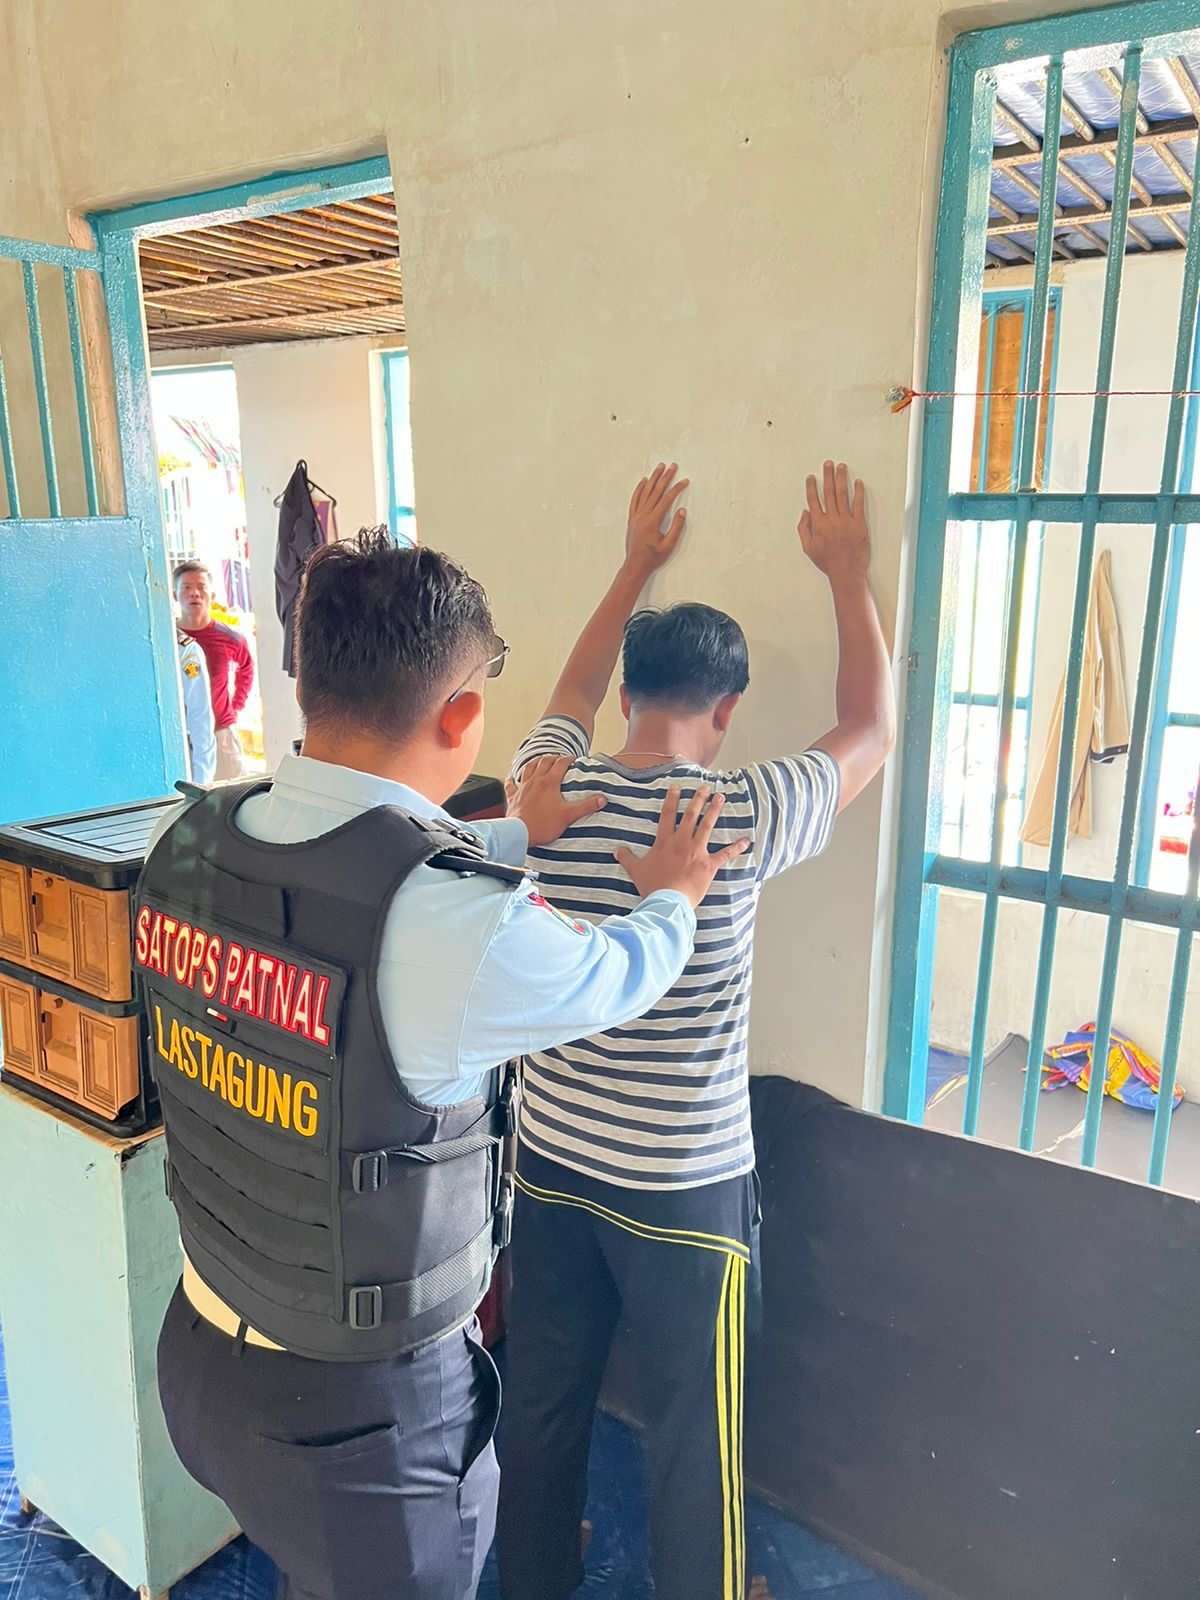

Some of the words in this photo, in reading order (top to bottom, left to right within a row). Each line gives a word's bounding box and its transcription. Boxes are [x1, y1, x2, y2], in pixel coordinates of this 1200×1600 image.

[135, 906, 222, 998] SATOPS
[220, 942, 330, 1046] PATNAL
[155, 1005, 318, 1136] LASTAGUNG
